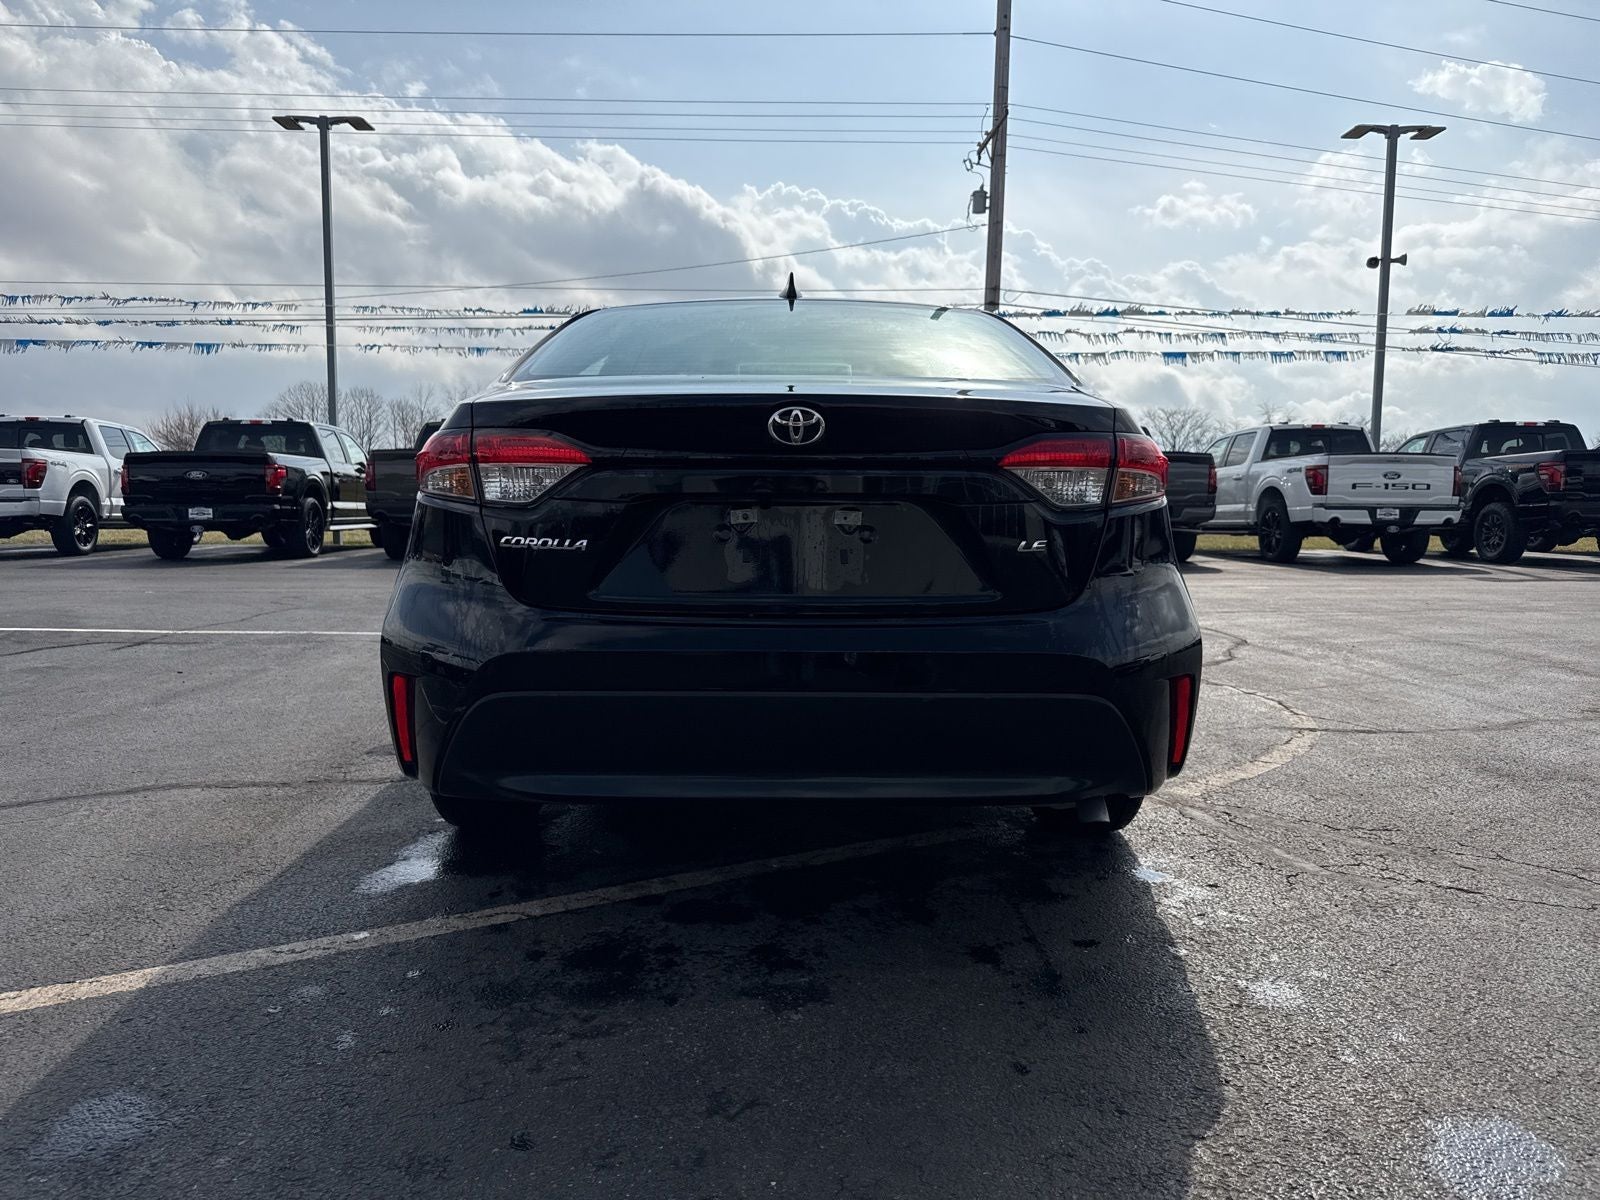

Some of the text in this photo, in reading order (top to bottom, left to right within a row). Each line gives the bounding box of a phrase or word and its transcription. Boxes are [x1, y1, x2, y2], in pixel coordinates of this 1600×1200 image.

[1351, 482, 1431, 491] F-150
[499, 536, 588, 551] COROLLA
[1017, 539, 1048, 552] LE
